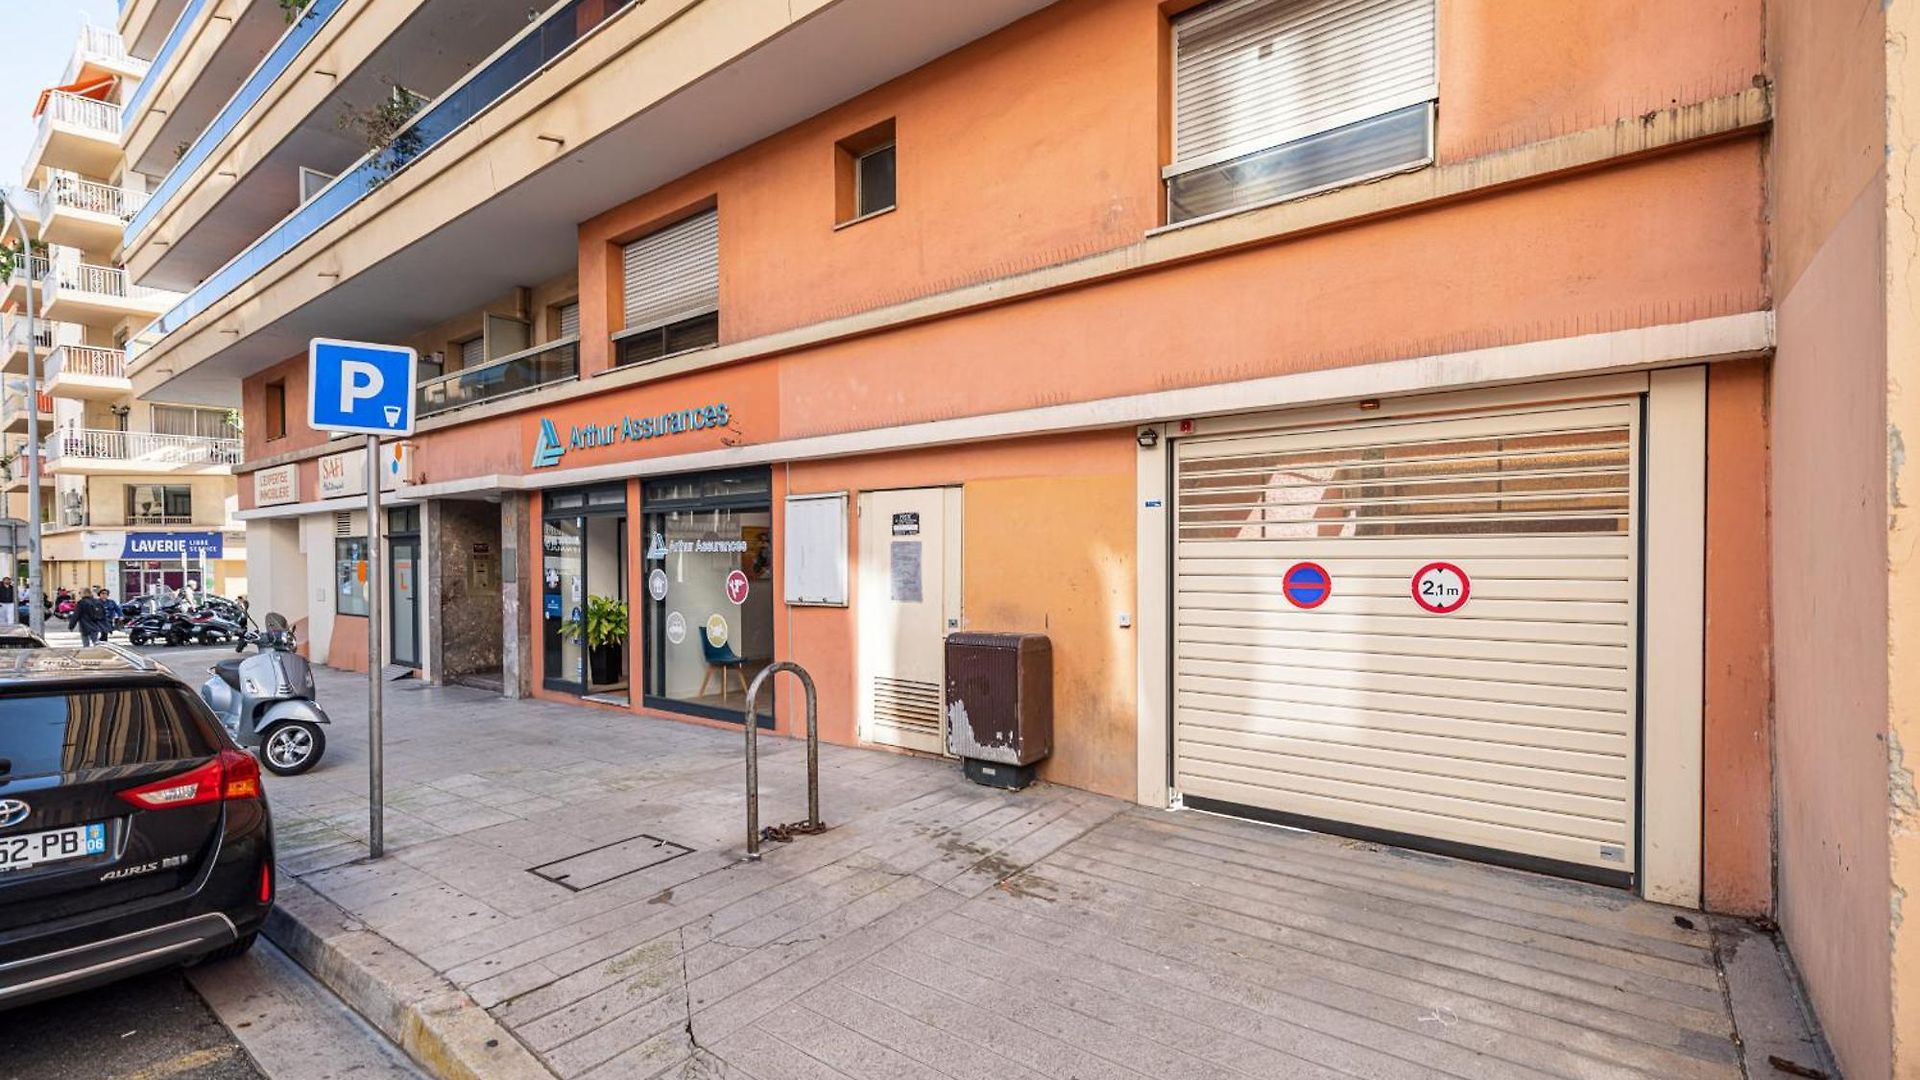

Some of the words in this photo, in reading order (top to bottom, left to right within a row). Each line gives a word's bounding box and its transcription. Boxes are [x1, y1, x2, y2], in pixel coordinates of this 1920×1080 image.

[340, 359, 385, 413] P
[569, 423, 616, 450] Arthur
[621, 403, 729, 442] Assurances
[131, 539, 187, 553] LAVERIE
[87, 838, 104, 851] 06
[100, 862, 159, 881] AURIS
